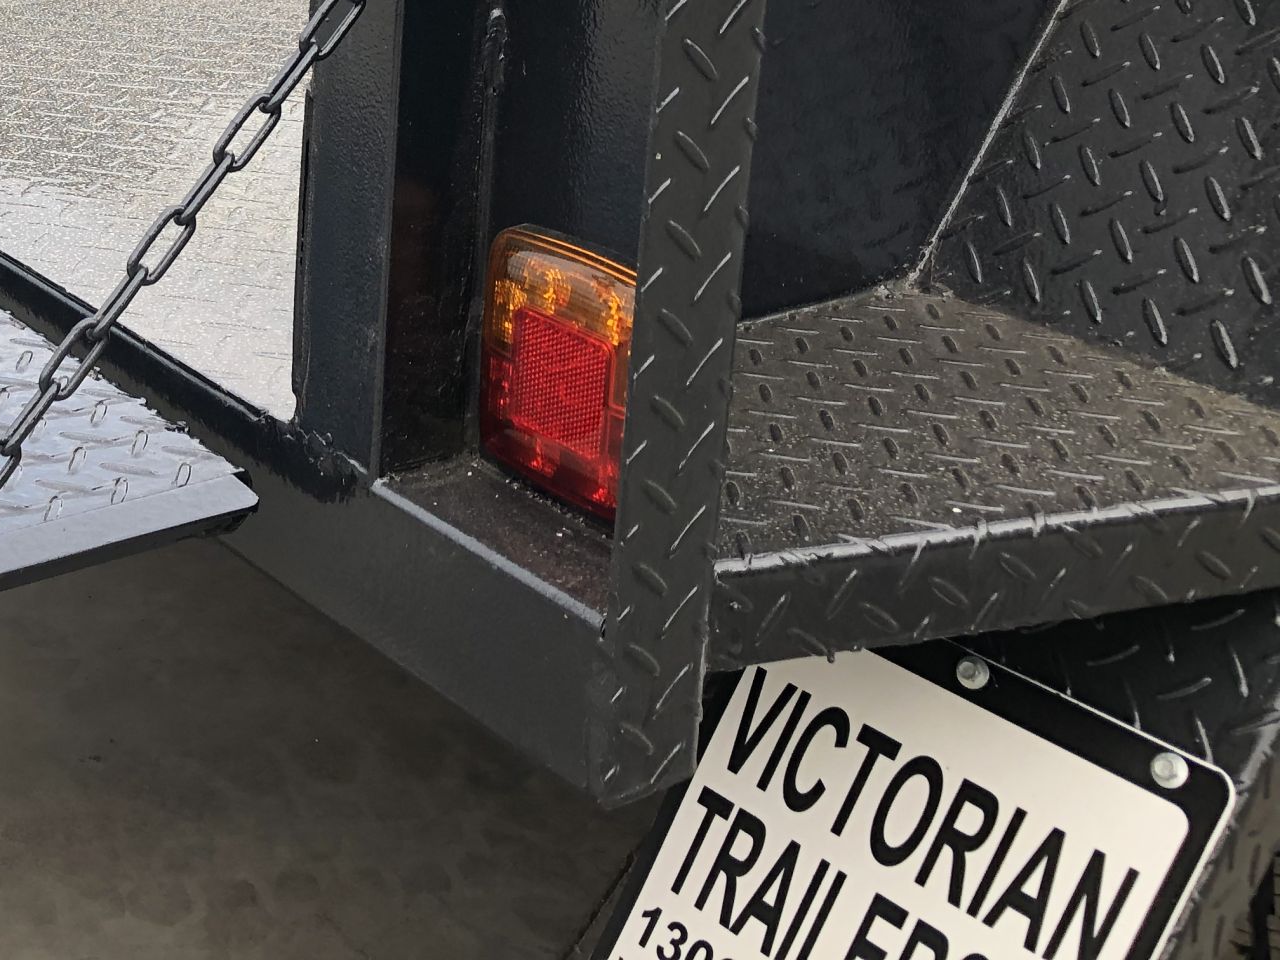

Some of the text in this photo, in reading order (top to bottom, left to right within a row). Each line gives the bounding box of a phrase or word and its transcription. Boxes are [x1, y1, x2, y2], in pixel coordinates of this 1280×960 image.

[670, 786, 989, 960] TRAILE
[727, 667, 1140, 960] VICTORIAN
[638, 906, 735, 960] 130
